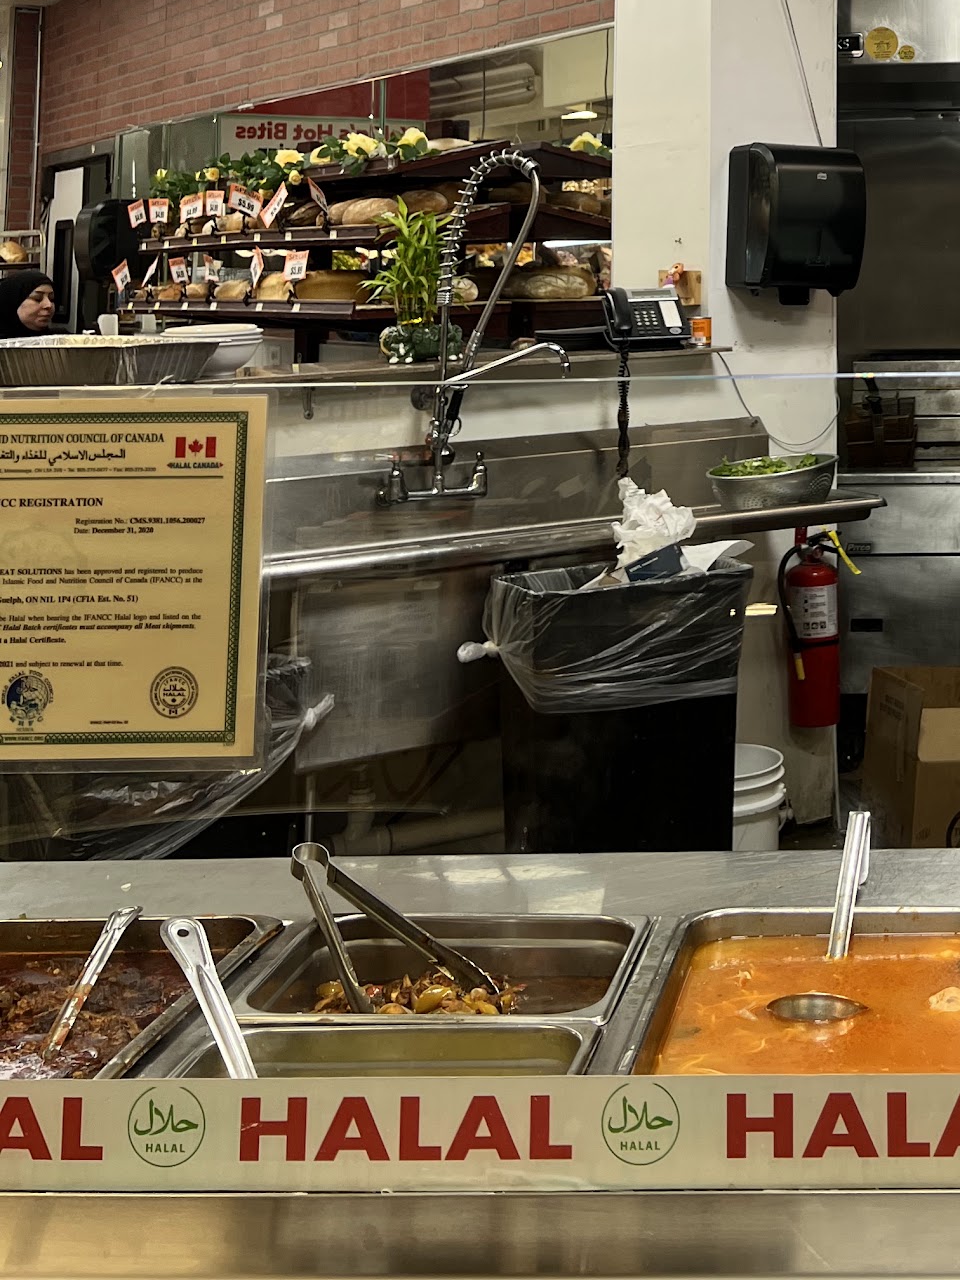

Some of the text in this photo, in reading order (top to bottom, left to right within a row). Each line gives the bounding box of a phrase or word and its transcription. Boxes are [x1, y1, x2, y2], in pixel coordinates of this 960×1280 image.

[10, 433, 165, 444] NUTRITION COUNCIL OF CANADA
[19, 497, 104, 508] REGISTRATION
[17, 568, 62, 576] SOLUTIONS
[133, 1099, 199, 1136] حلال
[607, 1096, 674, 1134] حلال
[239, 1094, 573, 1162] HALAL
[145, 1141, 186, 1154] HALAL
[619, 1139, 661, 1152] HALAL
